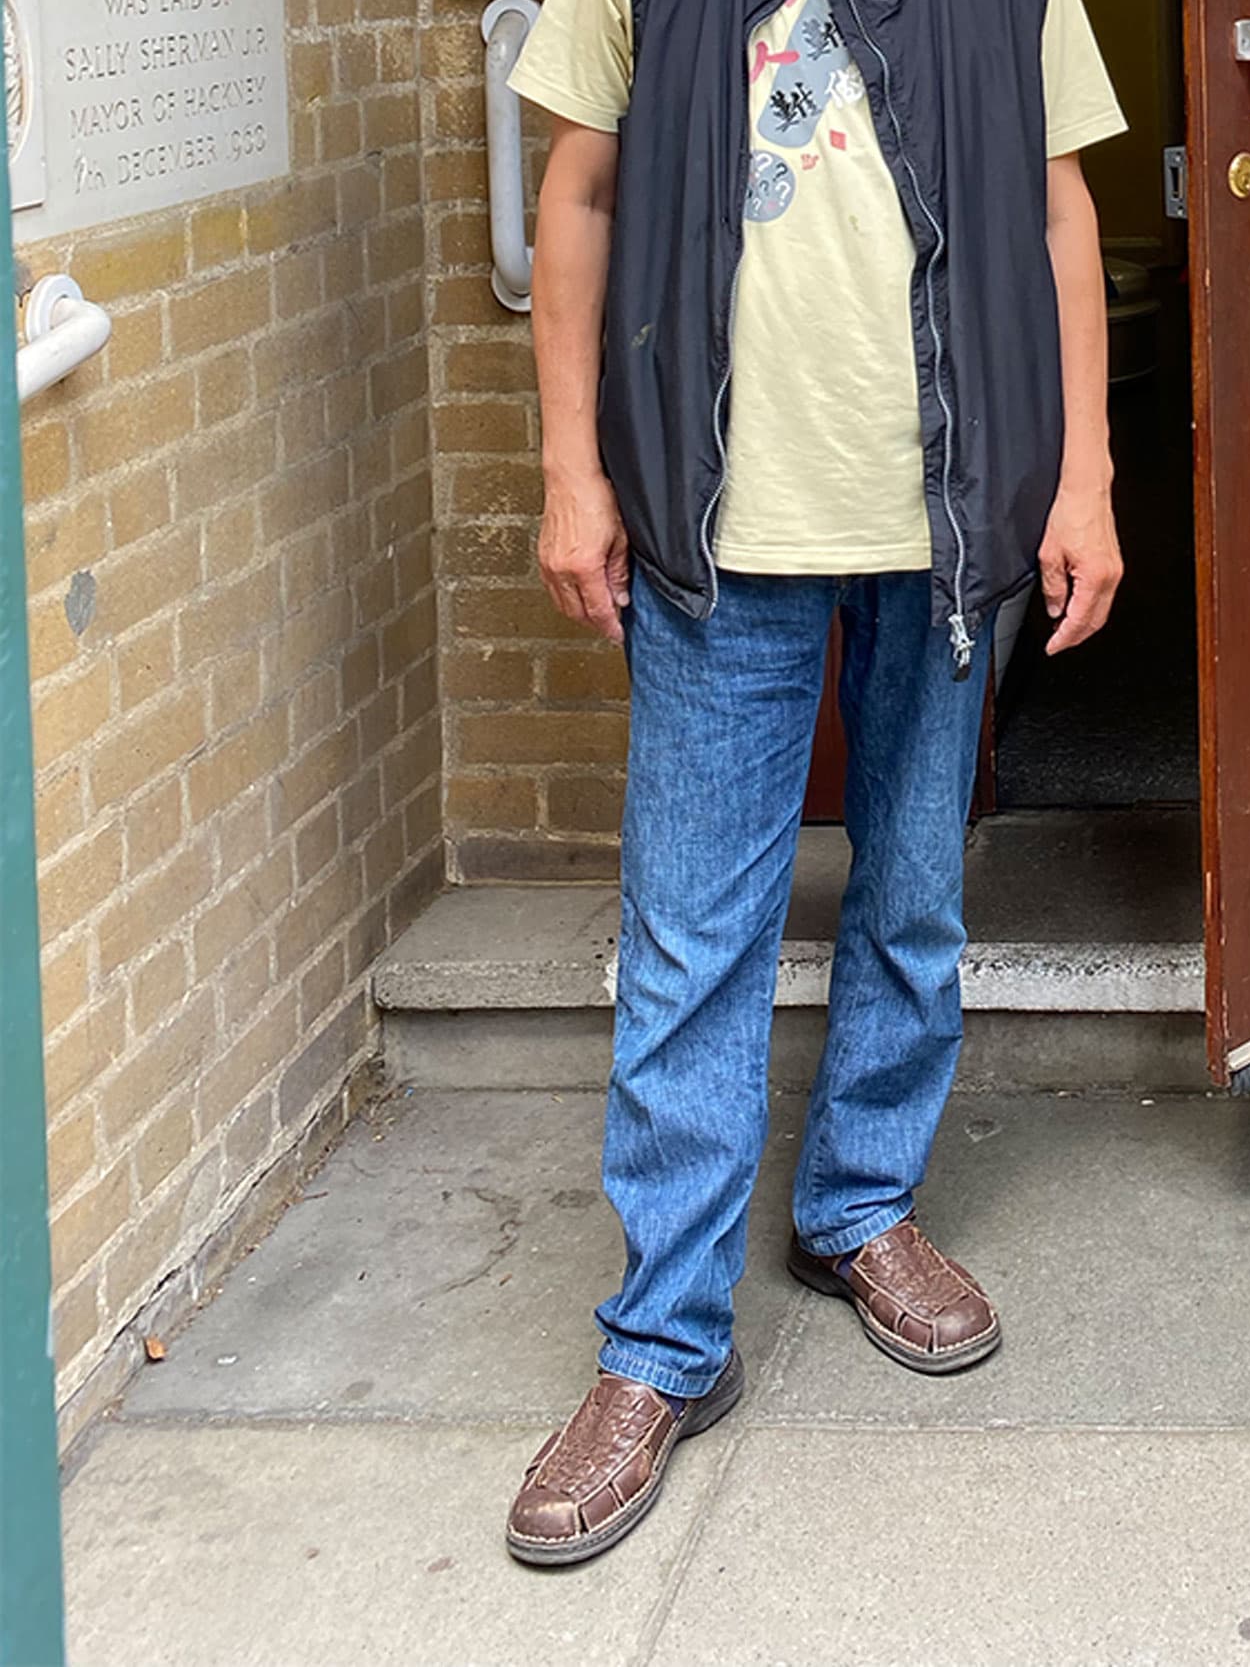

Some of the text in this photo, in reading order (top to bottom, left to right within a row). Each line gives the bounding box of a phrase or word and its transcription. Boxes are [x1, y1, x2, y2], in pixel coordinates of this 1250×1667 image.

[65, 40, 130, 82] SALLY
[139, 27, 235, 71] SHERMAN
[70, 76, 267, 139] MAYOR OF HACKNEY
[116, 134, 217, 186] DECEMBER
